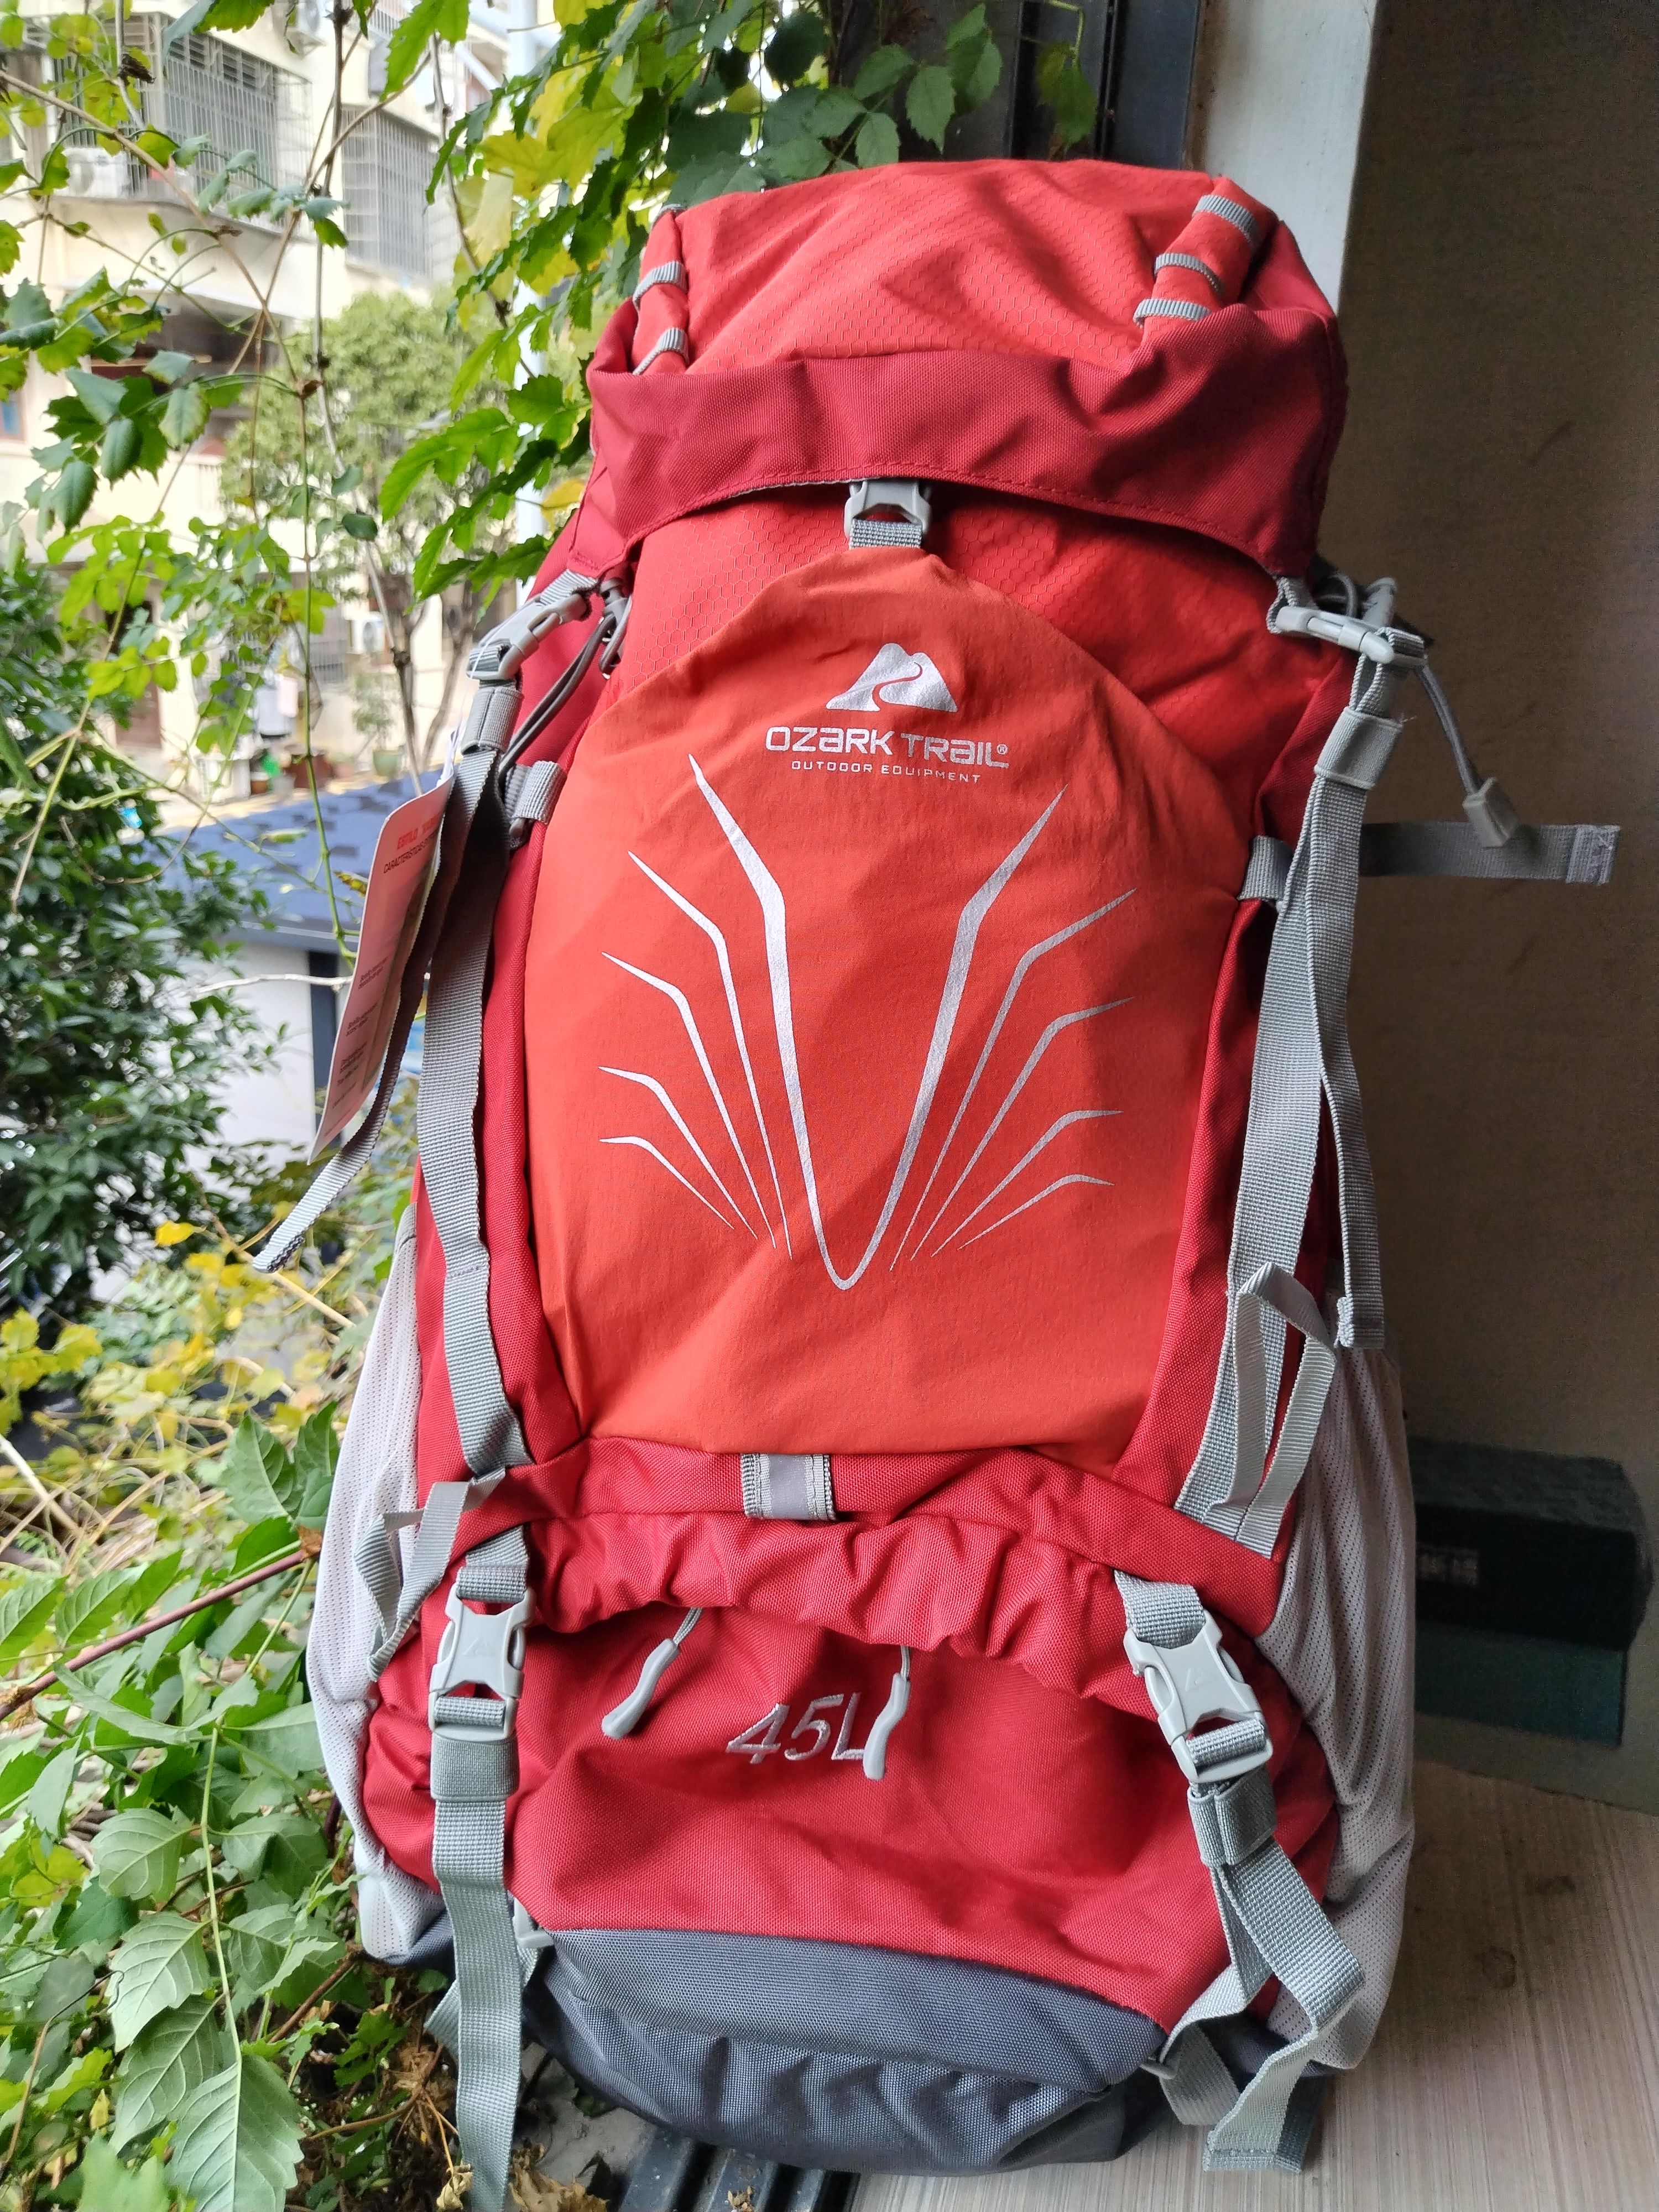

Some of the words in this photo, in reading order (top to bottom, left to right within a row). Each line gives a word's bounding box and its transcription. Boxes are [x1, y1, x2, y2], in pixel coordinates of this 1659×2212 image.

[765, 725, 895, 756] OZARK
[791, 760, 873, 773] OUTDOOR
[881, 765, 981, 784] EQUIPMENT
[726, 1692, 865, 1765] 45L
